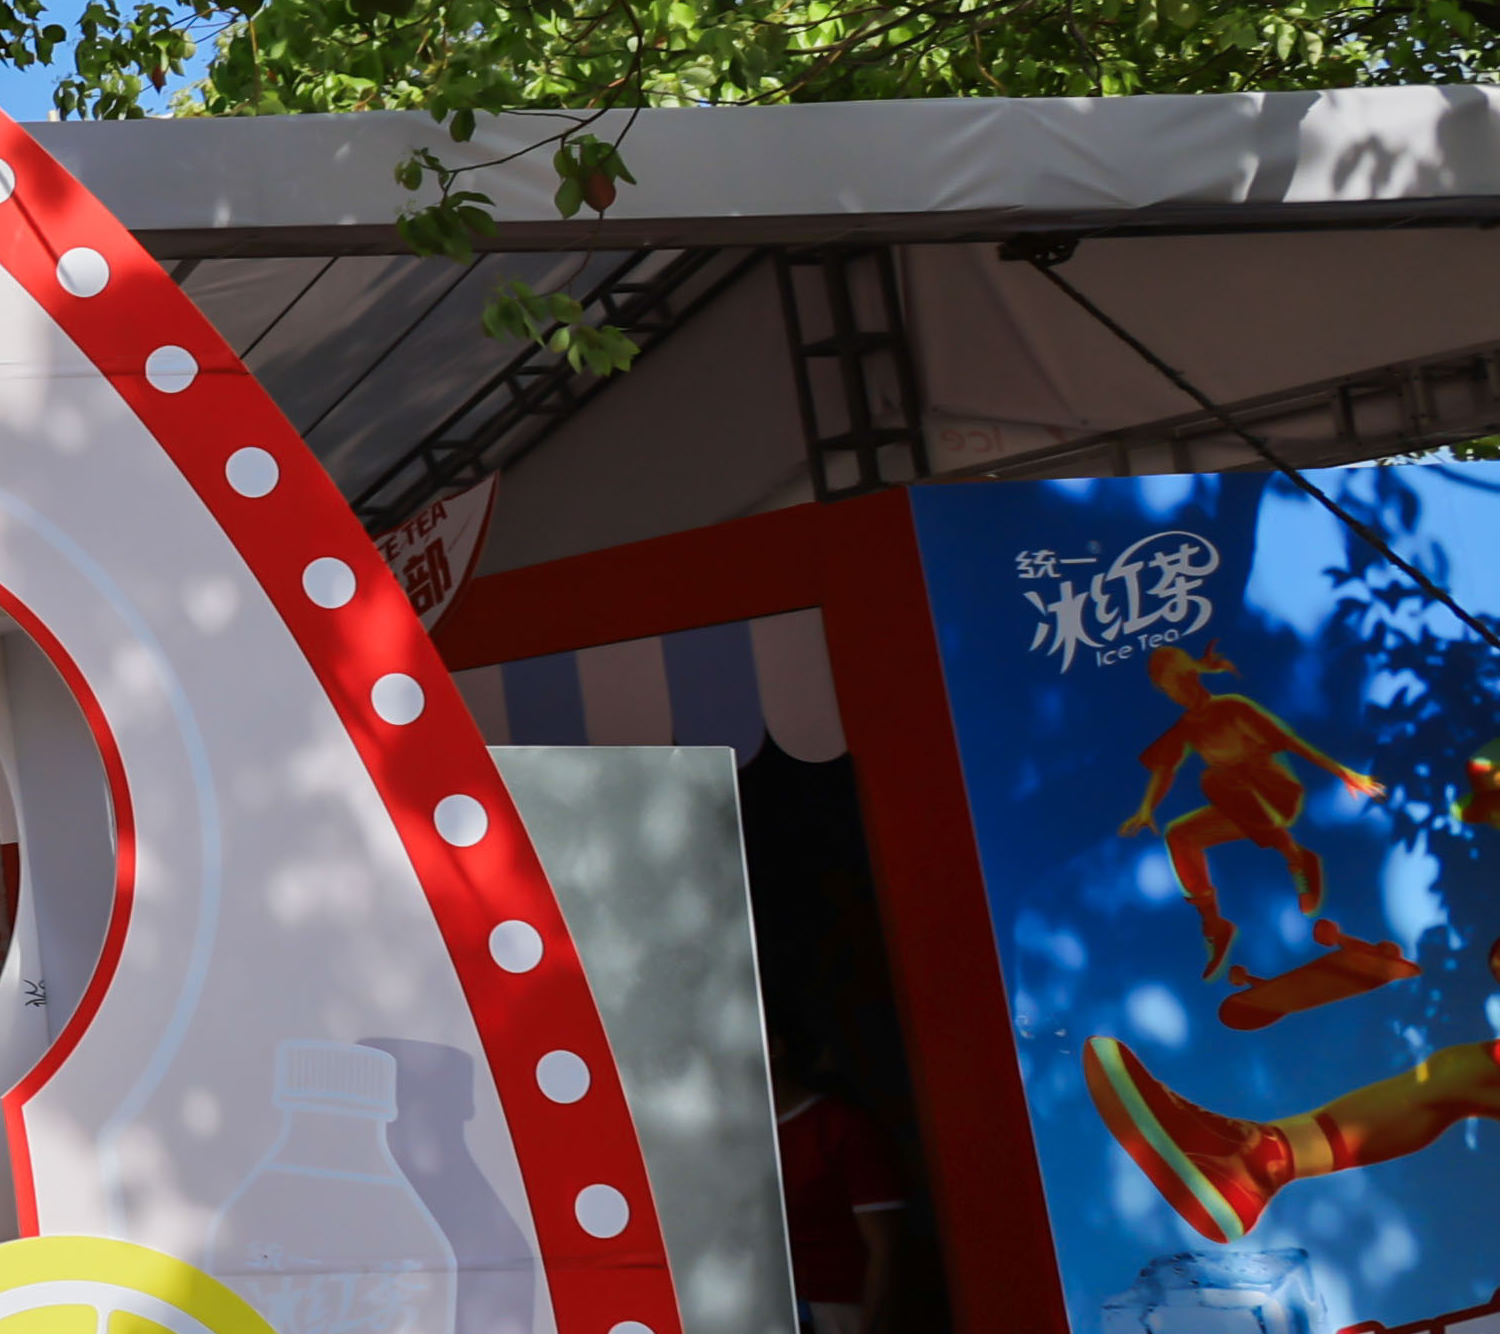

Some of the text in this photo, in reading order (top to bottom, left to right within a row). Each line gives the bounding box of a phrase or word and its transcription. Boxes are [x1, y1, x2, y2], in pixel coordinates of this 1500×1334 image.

[1014, 548, 1097, 579] 统一
[1022, 530, 1220, 675] 冰红茶
[1095, 628, 1180, 667] Ice Tea
